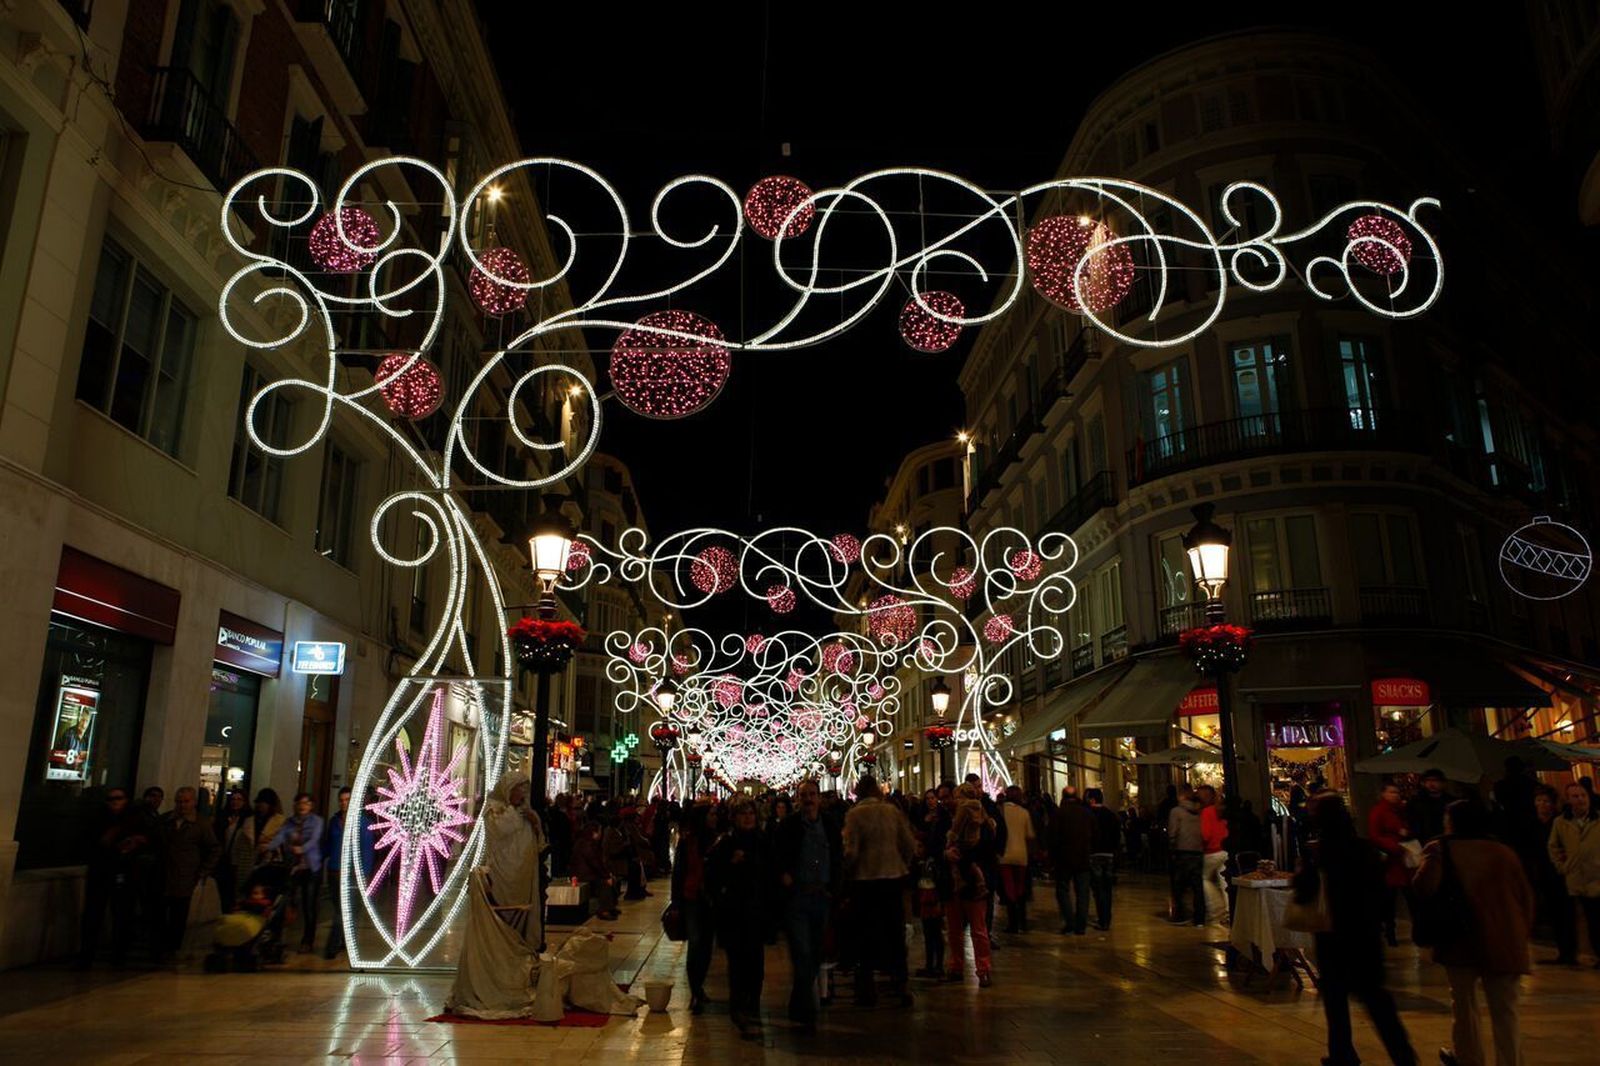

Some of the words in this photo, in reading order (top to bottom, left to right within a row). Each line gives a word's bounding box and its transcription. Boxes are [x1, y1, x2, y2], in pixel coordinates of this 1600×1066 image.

[227, 628, 246, 644] BANCO
[245, 636, 267, 650] POPULAR
[1378, 683, 1423, 699] SNACKS
[1180, 692, 1219, 710] CAFETER
